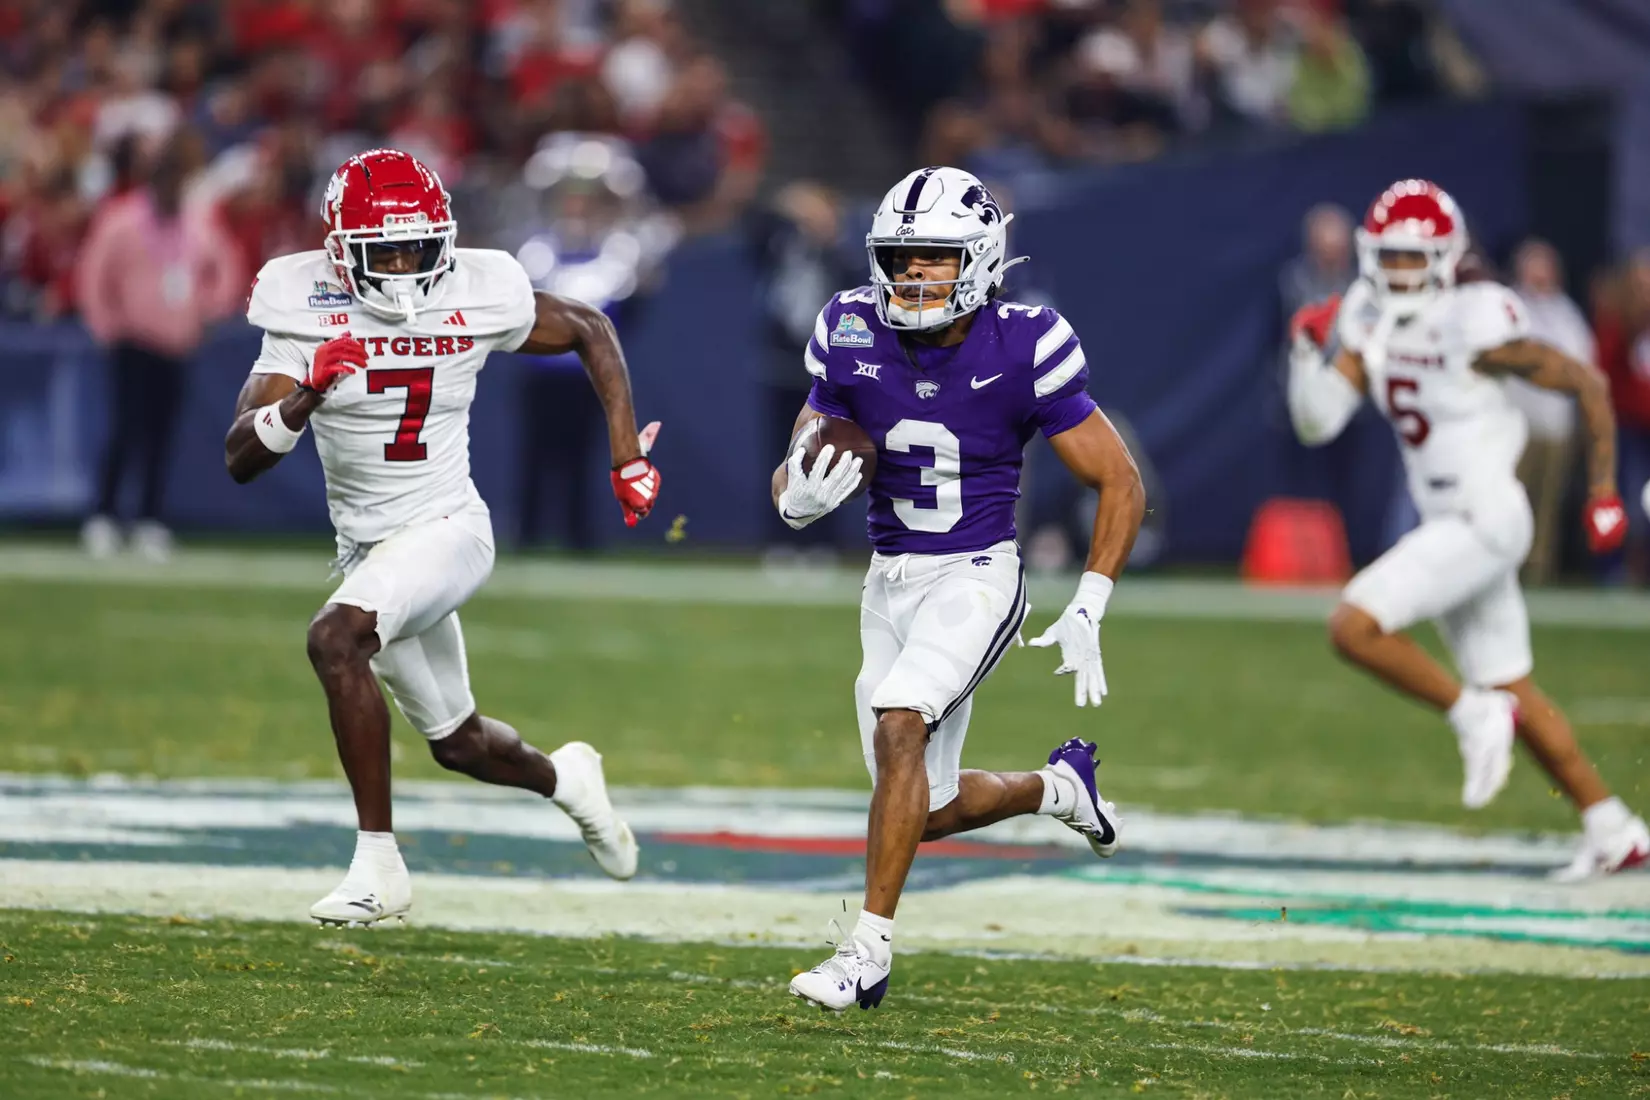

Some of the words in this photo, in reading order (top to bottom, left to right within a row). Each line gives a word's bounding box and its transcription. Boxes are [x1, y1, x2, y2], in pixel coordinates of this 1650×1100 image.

[895, 225, 915, 237] Cats
[309, 296, 351, 307] RateBowl
[324, 335, 475, 357] TGERS
[832, 333, 872, 345] RateBowl
[853, 359, 881, 381] XII
[366, 367, 434, 462] 7
[1386, 376, 1430, 448] 5
[885, 418, 964, 534] 3
